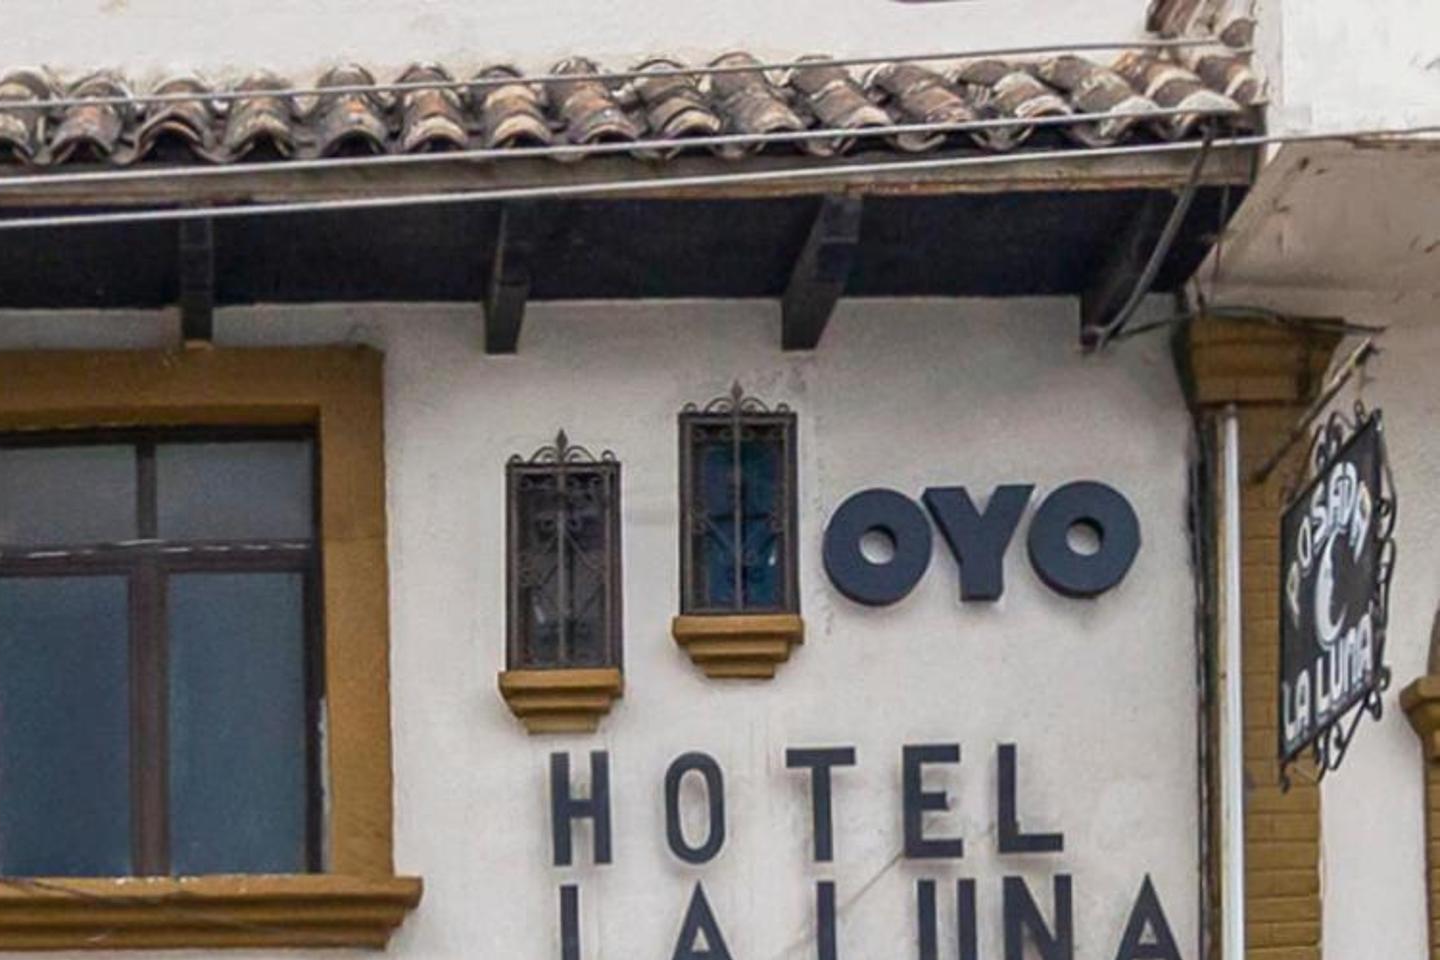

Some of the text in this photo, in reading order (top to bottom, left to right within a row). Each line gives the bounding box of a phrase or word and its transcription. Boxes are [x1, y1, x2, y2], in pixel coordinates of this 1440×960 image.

[822, 480, 1143, 606] OYO
[1286, 461, 1373, 630] POSADA
[1282, 612, 1373, 742] LA LUNA
[550, 743, 1065, 867] HOTEL
